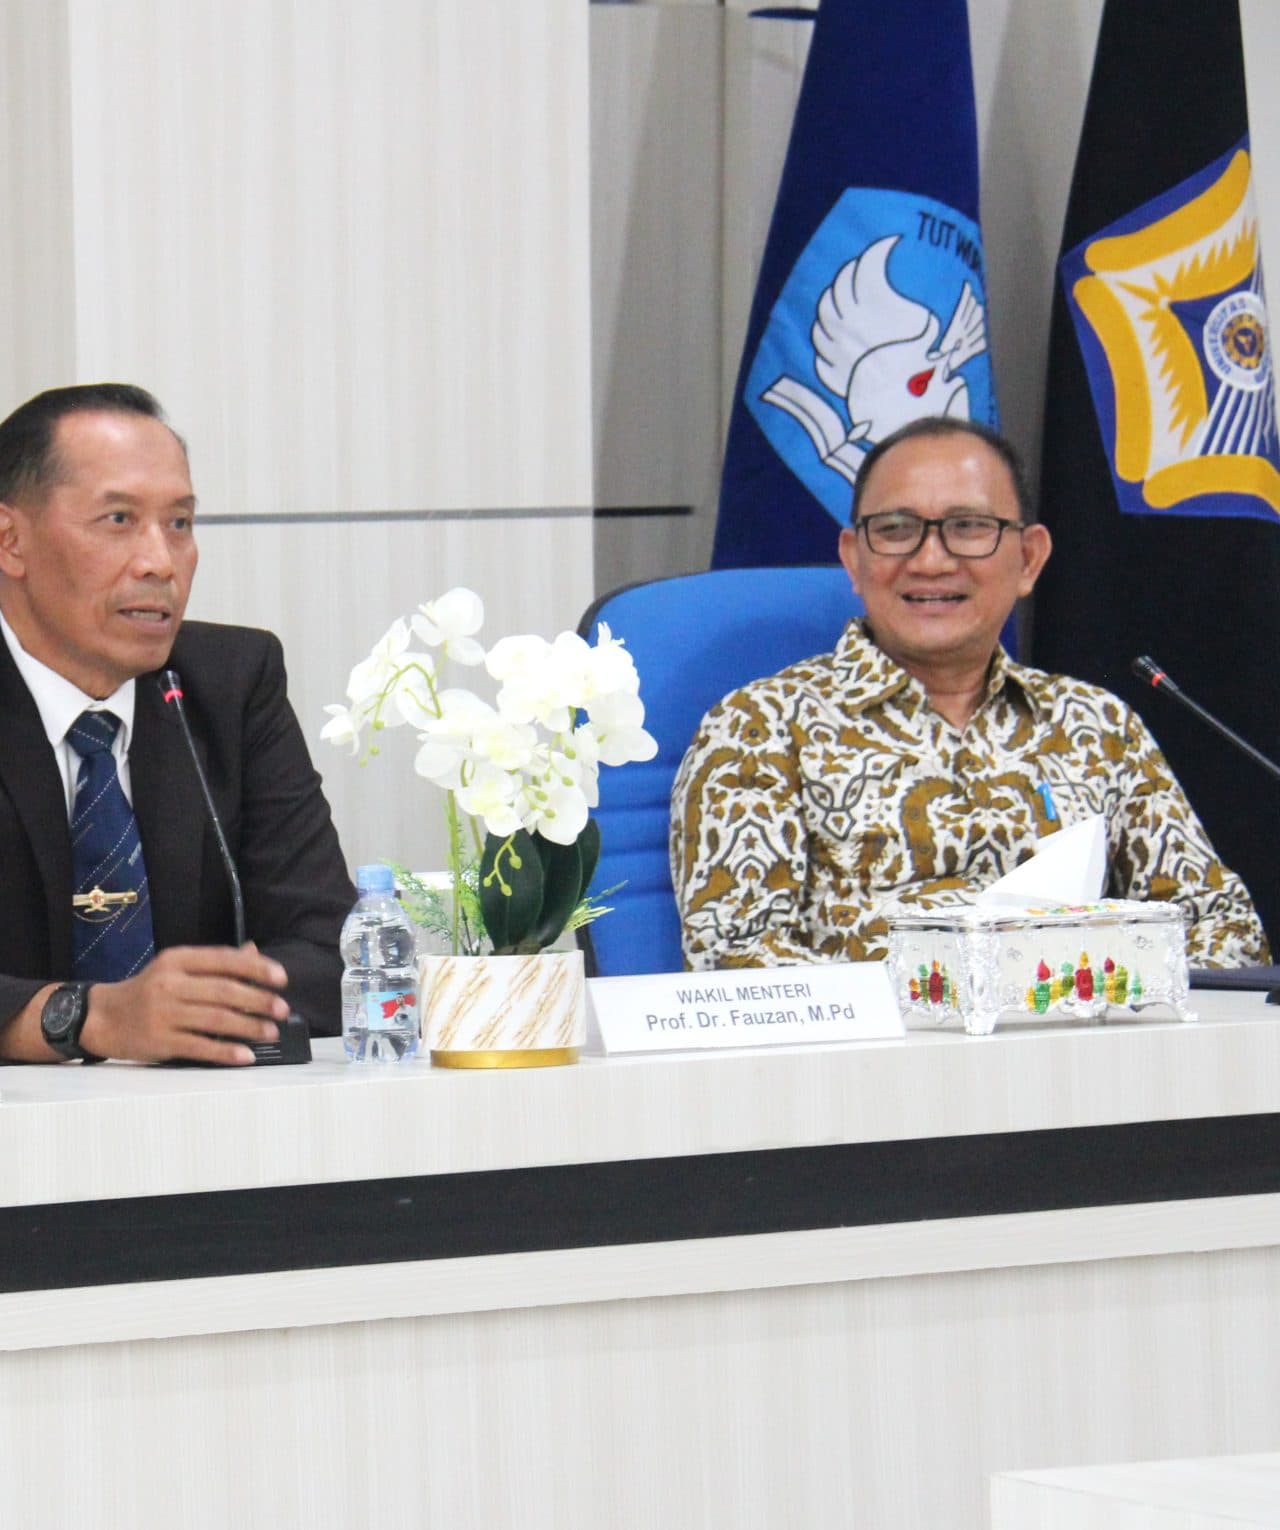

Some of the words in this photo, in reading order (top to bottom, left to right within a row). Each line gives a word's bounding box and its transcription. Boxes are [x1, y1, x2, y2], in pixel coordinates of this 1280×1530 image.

[918, 210, 956, 250] TUT
[676, 987, 733, 1005] WAKIL
[736, 983, 812, 1001] MENTERI
[646, 1012, 693, 1031] Prof.
[696, 1011, 726, 1029] Dr.
[730, 1007, 805, 1027] Fauzan,
[807, 1003, 856, 1023] M.Pd
